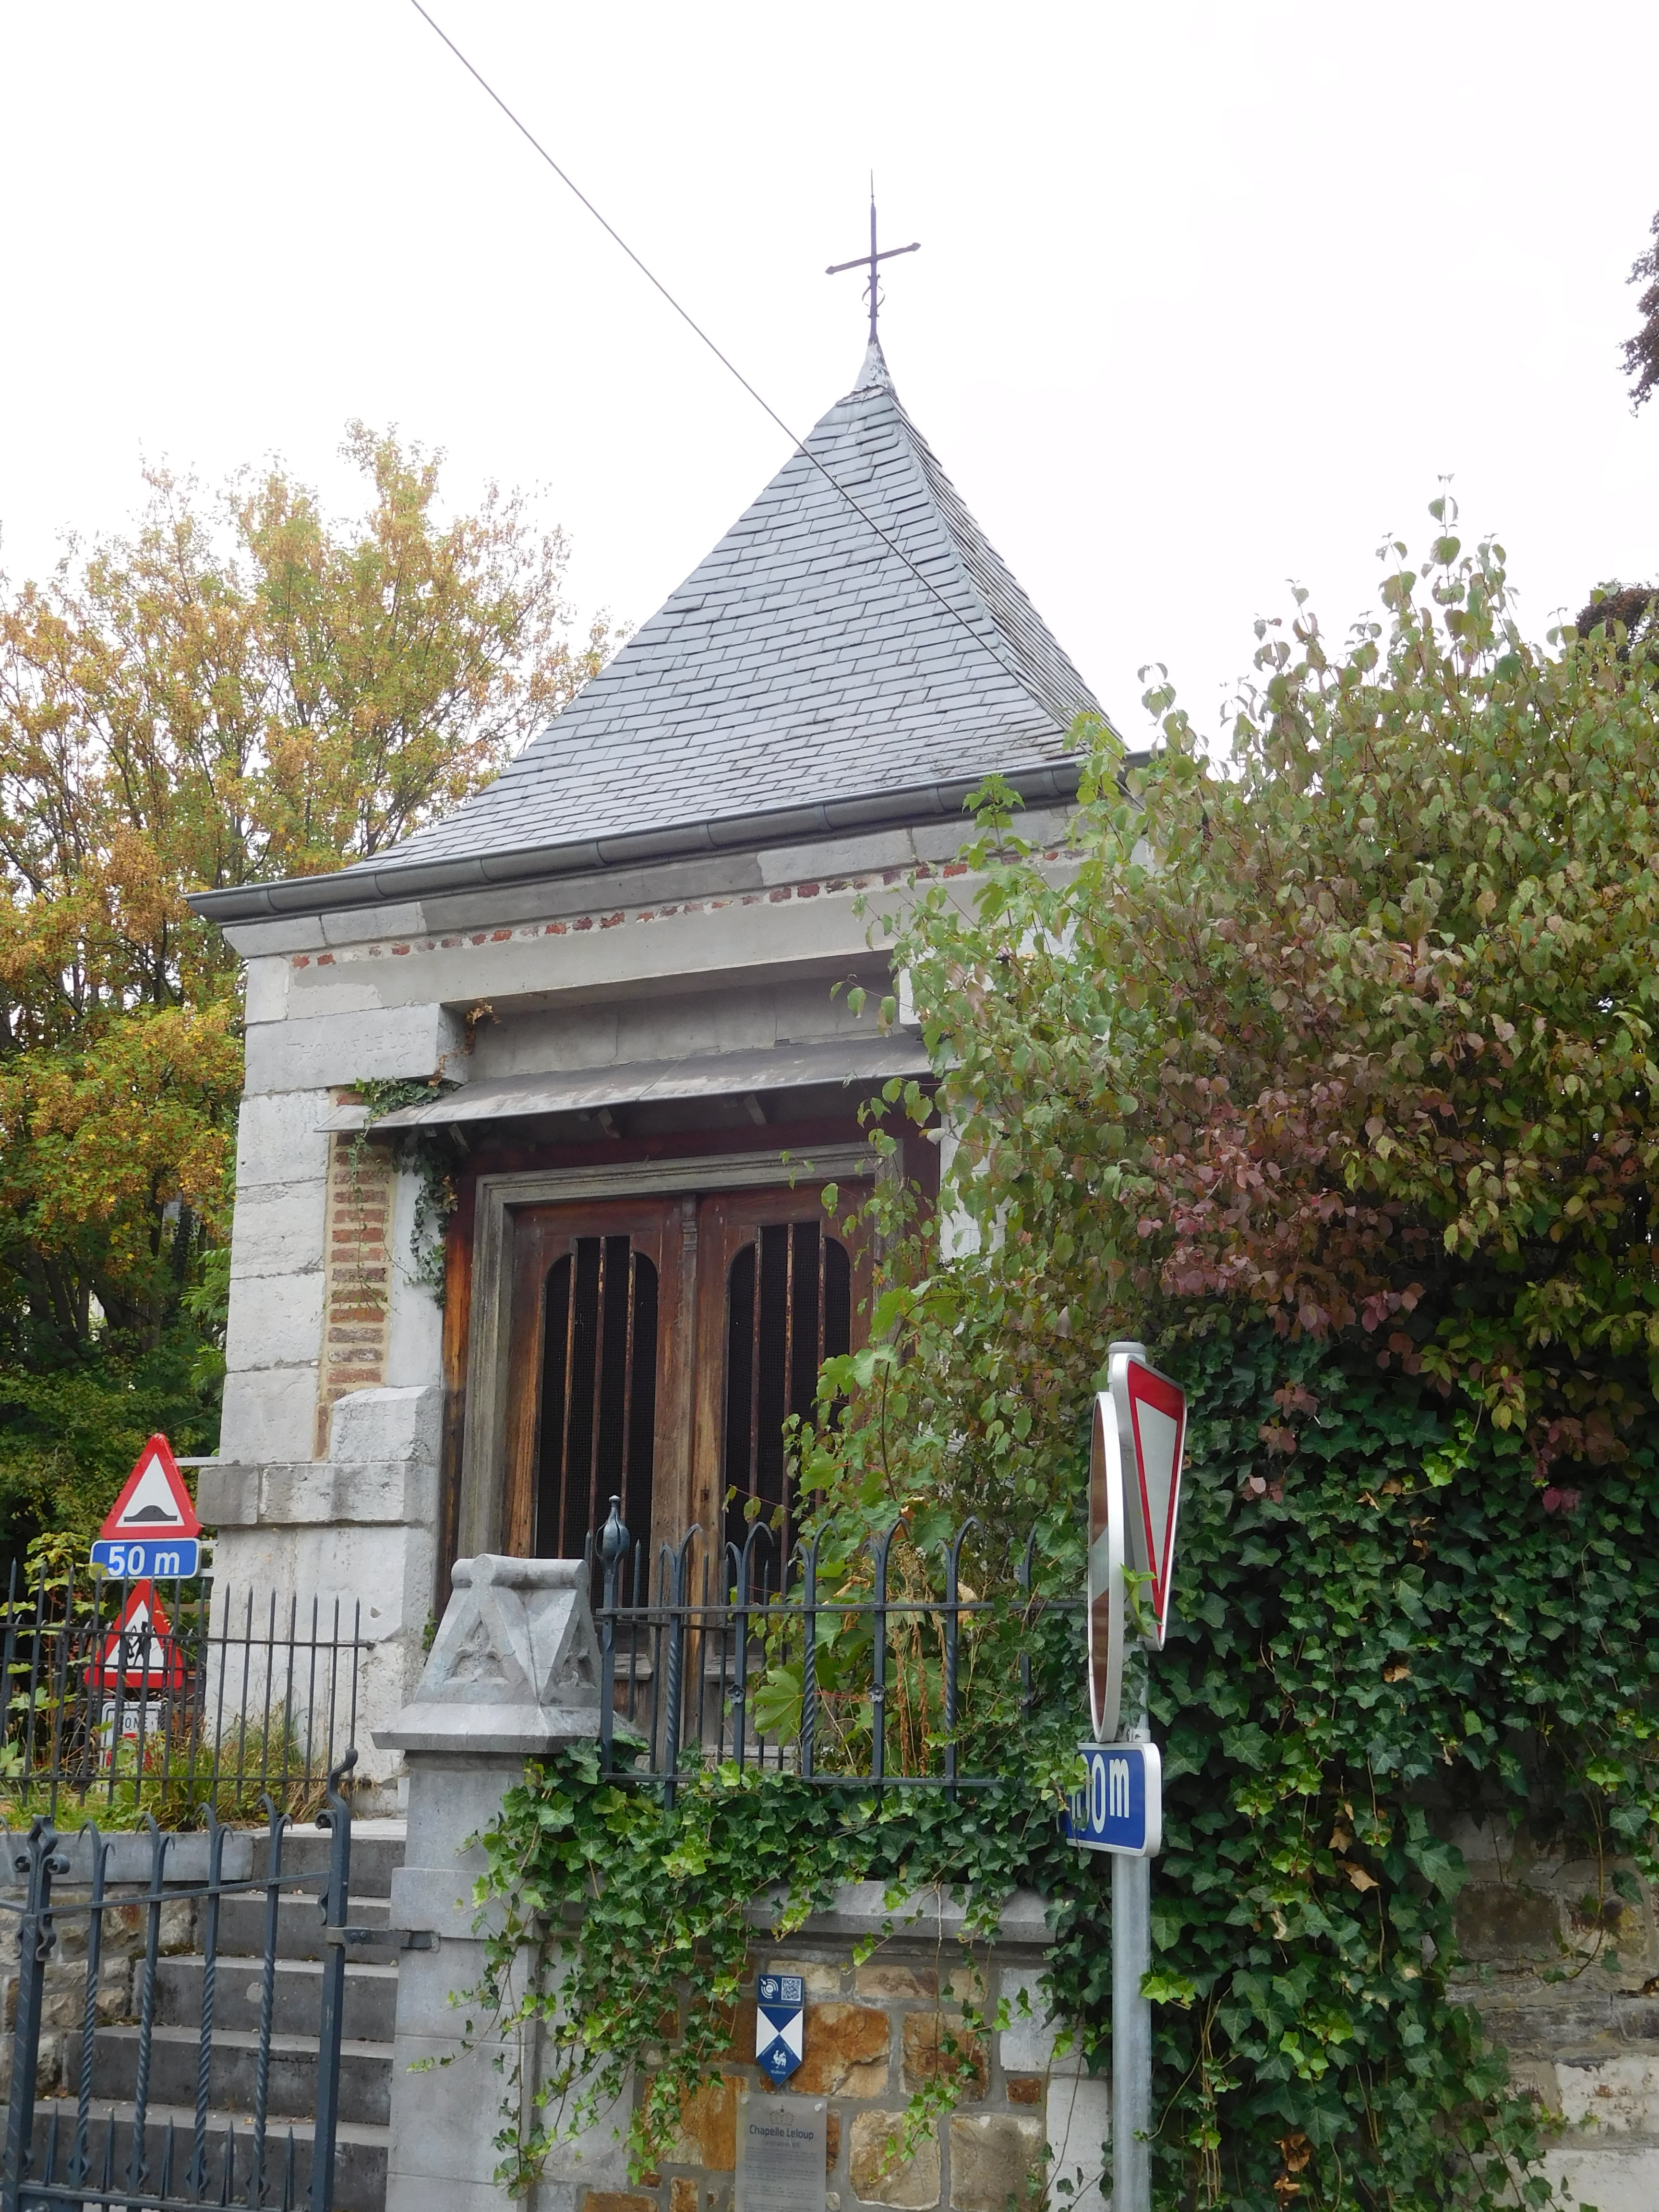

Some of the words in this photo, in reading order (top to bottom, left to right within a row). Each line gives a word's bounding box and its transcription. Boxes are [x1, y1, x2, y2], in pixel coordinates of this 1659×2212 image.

[108, 1546, 145, 1576] 50
[154, 1552, 180, 1574] m
[749, 2124, 784, 2137] Chapelle
[787, 2128, 814, 2141] Leloup
